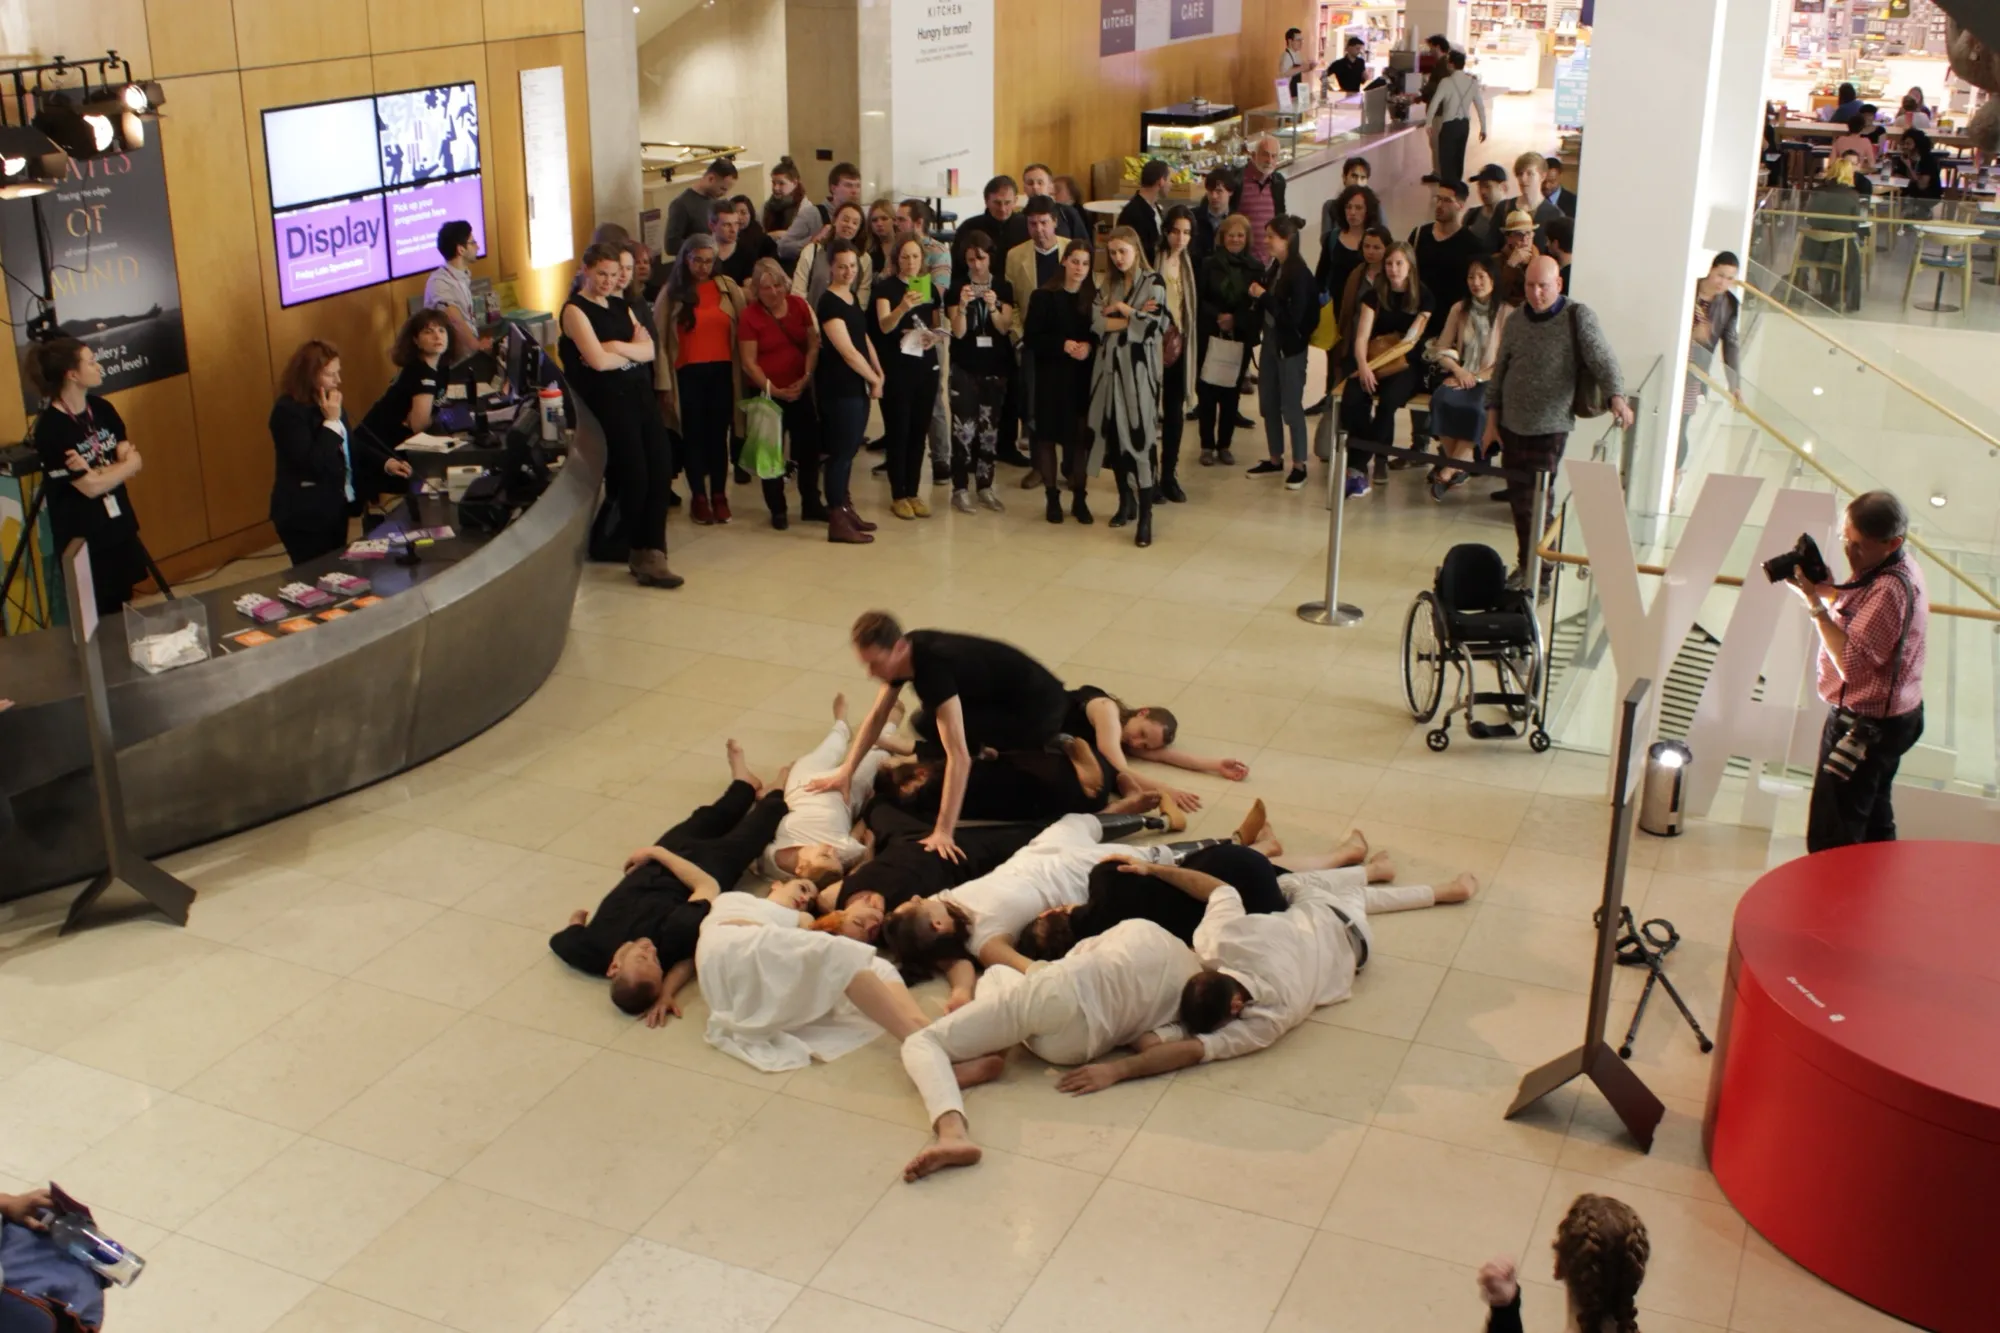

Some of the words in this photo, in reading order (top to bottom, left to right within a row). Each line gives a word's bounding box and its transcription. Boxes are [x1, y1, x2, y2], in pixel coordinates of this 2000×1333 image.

[927, 4, 962, 18] KITCHEN
[917, 27, 941, 41] Hungry
[942, 24, 951, 36] for
[952, 20, 972, 34] more?
[1102, 14, 1134, 30] KITCHEN
[286, 215, 381, 260] Display
[51, 255, 139, 300] MIND
[120, 345, 127, 355] 2
[107, 365, 120, 376] on
[121, 355, 143, 372] level
